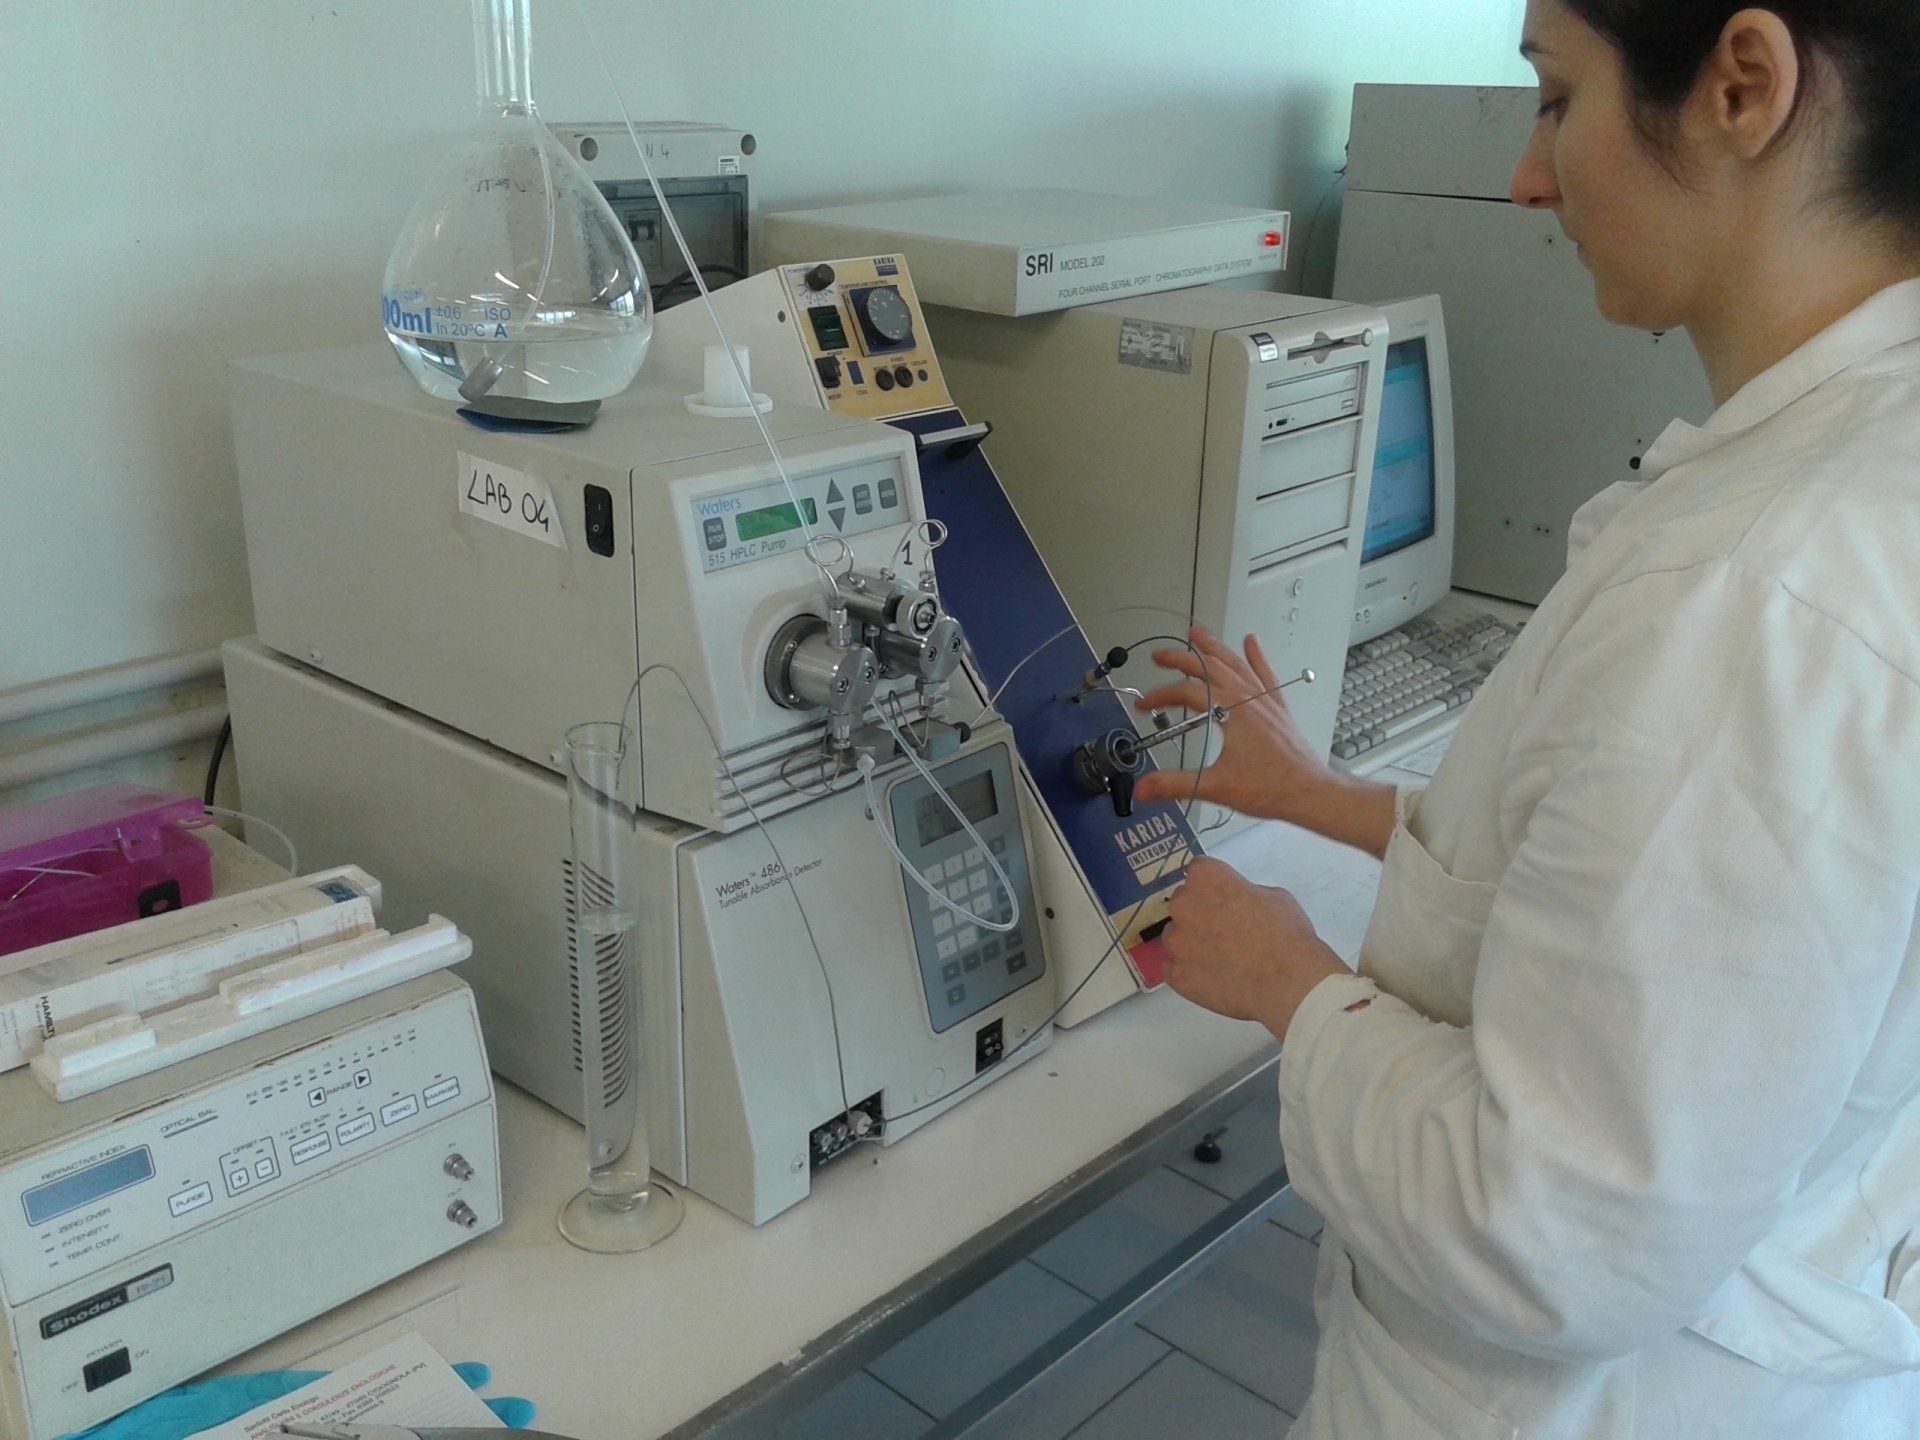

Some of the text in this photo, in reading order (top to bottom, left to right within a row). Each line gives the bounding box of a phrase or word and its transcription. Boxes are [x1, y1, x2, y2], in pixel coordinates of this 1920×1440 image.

[1025, 252, 1105, 277] SRI MODEL 202
[1059, 287, 1078, 298] FOUR
[1079, 282, 1109, 295] CHANNEL
[1110, 278, 1131, 290] SERIAL
[1134, 275, 1151, 286] PORT
[1155, 264, 1213, 282] CHROMATOGRAPHY
[1229, 258, 1252, 271] SYSTEM
[485, 307, 512, 321] ISO
[494, 323, 508, 338] A
[467, 469, 549, 533] LAB 04
[697, 498, 742, 517] Waters
[708, 538, 787, 567] 515 HPLC Pump
[901, 540, 914, 565] 1
[1113, 811, 1177, 852] KARIBA
[715, 877, 751, 898] Waters
[760, 861, 781, 878] 486
[718, 889, 749, 910] Tunable
[793, 858, 822, 877] Detector
[326, 1081, 353, 1096] RANGE
[389, 1103, 412, 1118] ZERO
[159, 1115, 196, 1133] OPTICAL
[339, 1121, 371, 1138] POLARITY
[232, 1139, 258, 1155] OFFSET
[41, 1144, 126, 1181] REFRACTIVE INDEX
[175, 1191, 205, 1208] PURGE
[58, 1219, 85, 1234] ZERO
[61, 1223, 109, 1247] INTENSITY
[49, 1295, 123, 1333] Shodex
